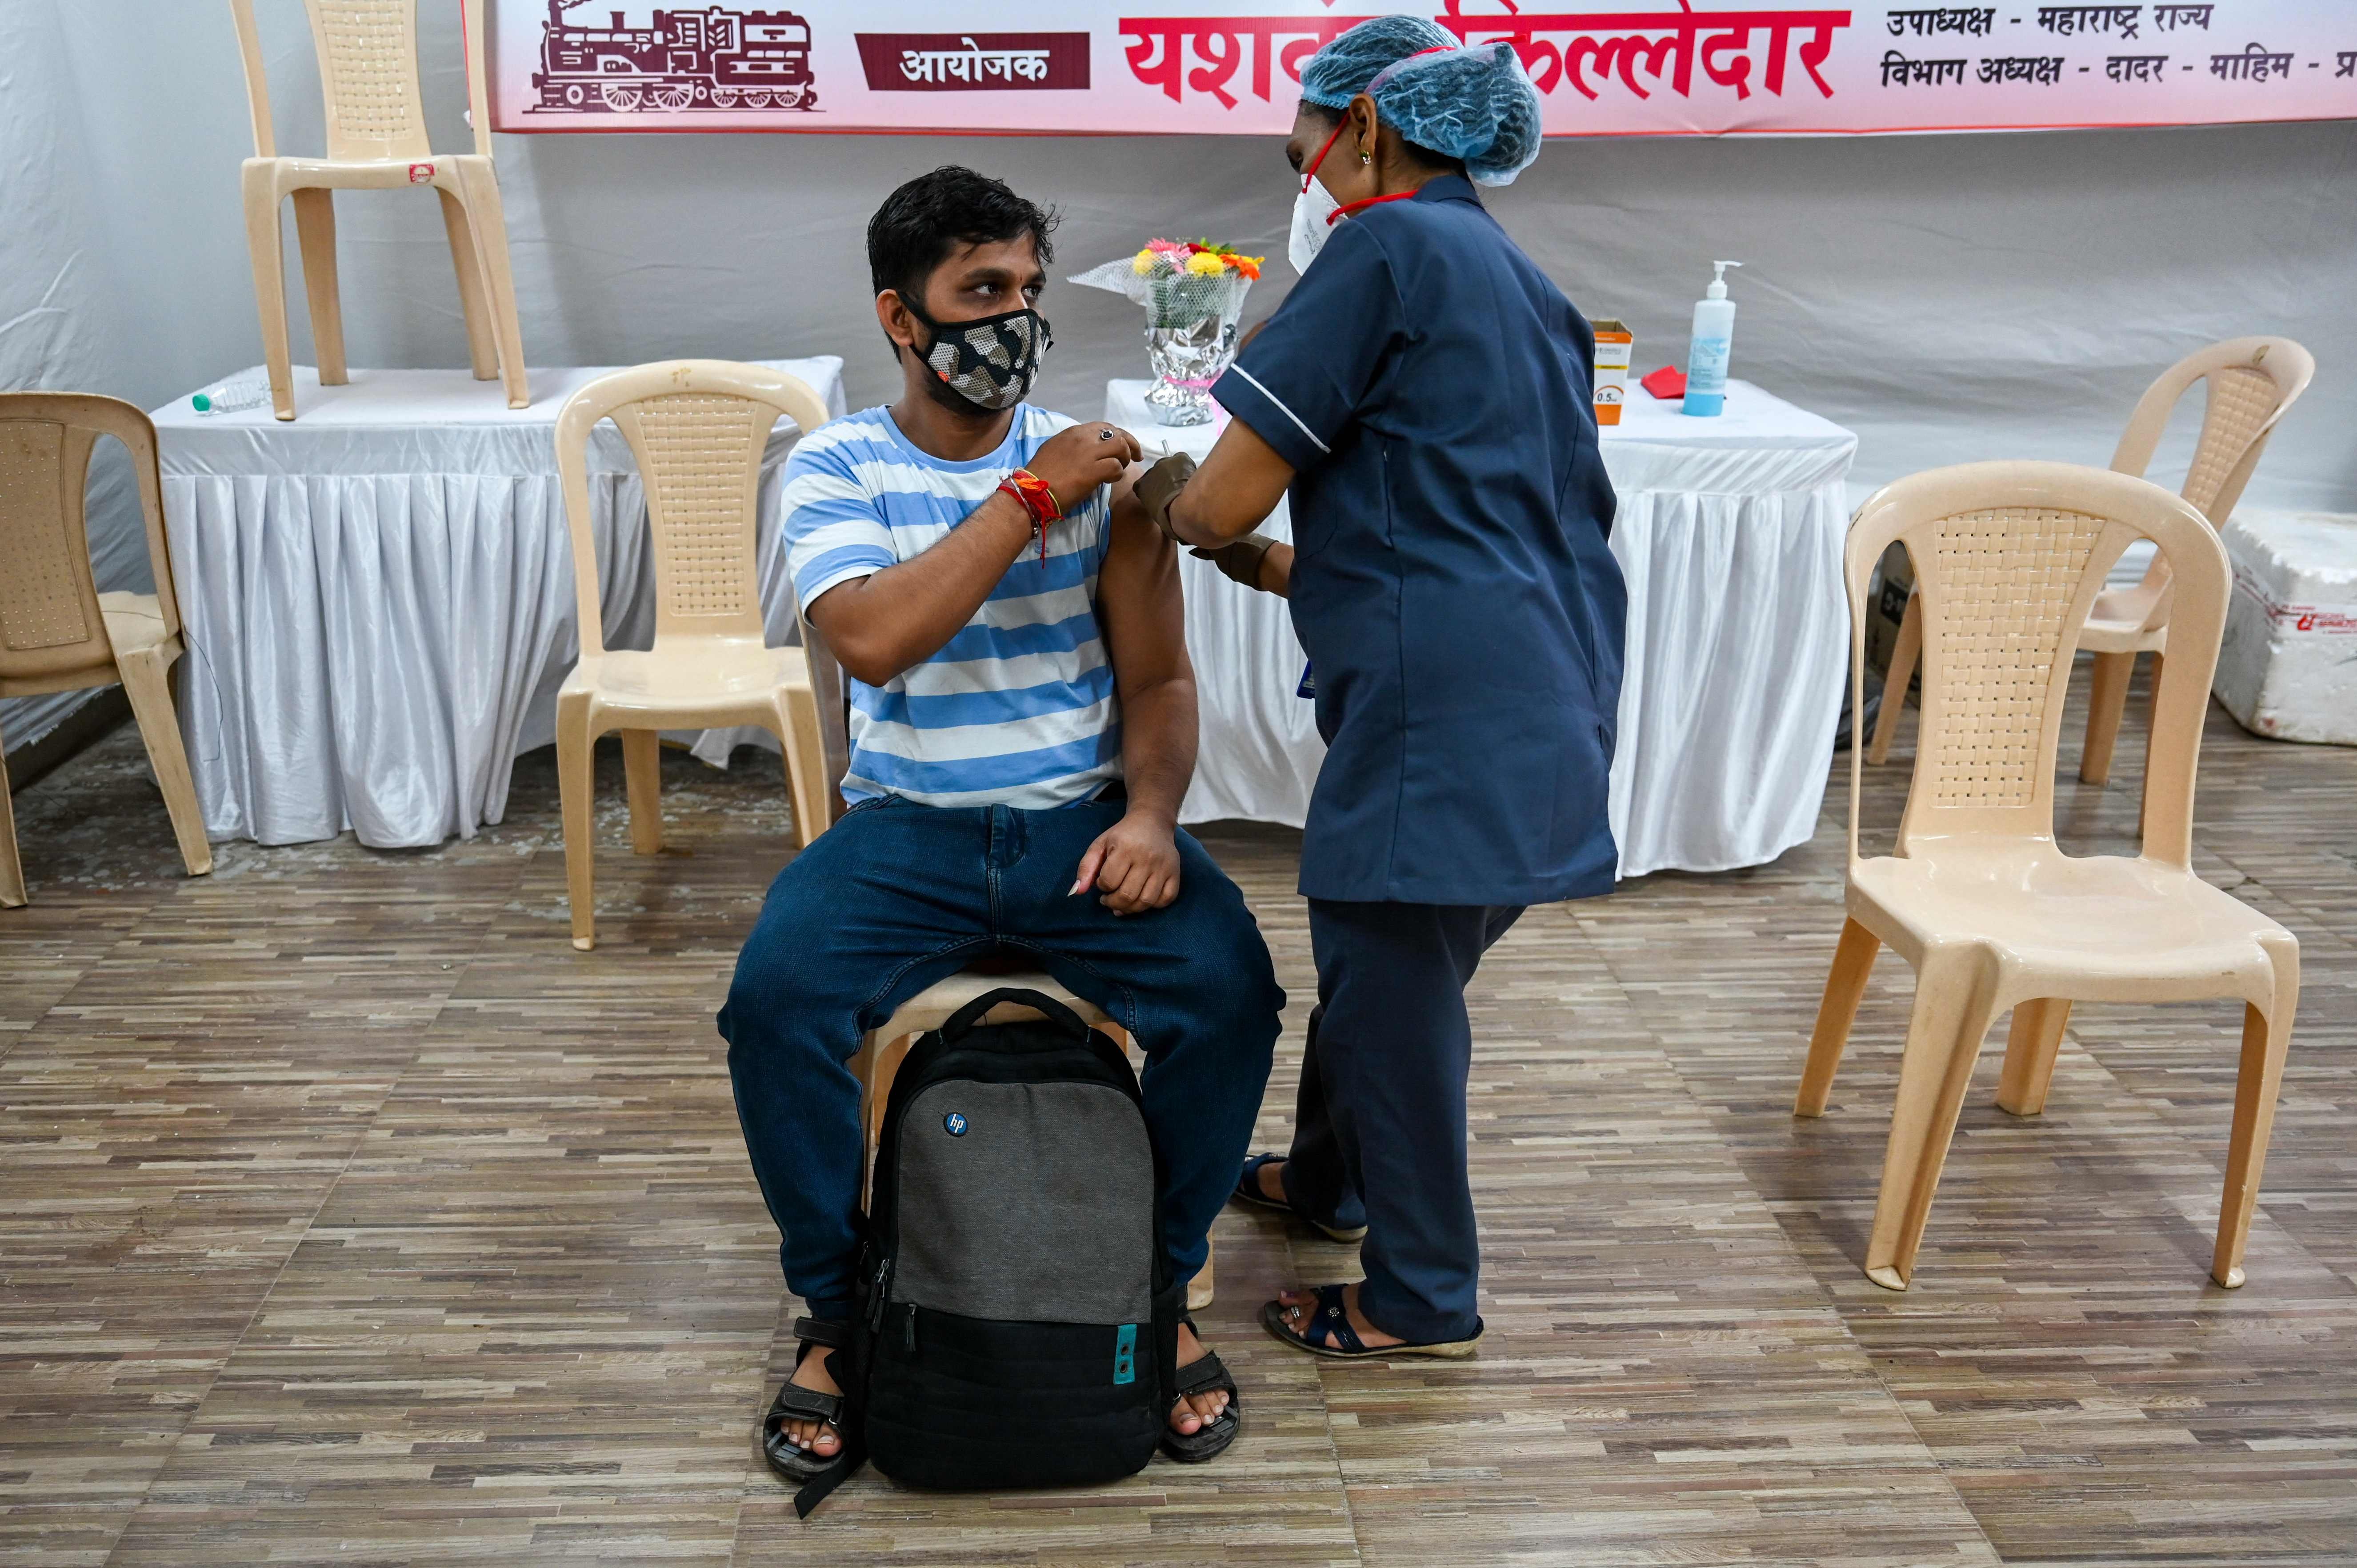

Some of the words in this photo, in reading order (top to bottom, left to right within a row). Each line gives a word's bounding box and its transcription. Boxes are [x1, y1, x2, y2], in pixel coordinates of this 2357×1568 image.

[1887, 8, 1996, 37] उपाध्यक्ष
[2037, 5, 2142, 39] महाराष्ट्र
[2153, 4, 2214, 32] राज्य
[899, 37, 1050, 83] आयोजक
[1880, 50, 1968, 87] विभाग
[1976, 56, 2065, 86] अध्यक्ष
[2106, 56, 2169, 83] दादर
[2210, 43, 2294, 83] माहिम
[950, 1113, 964, 1133] hp
